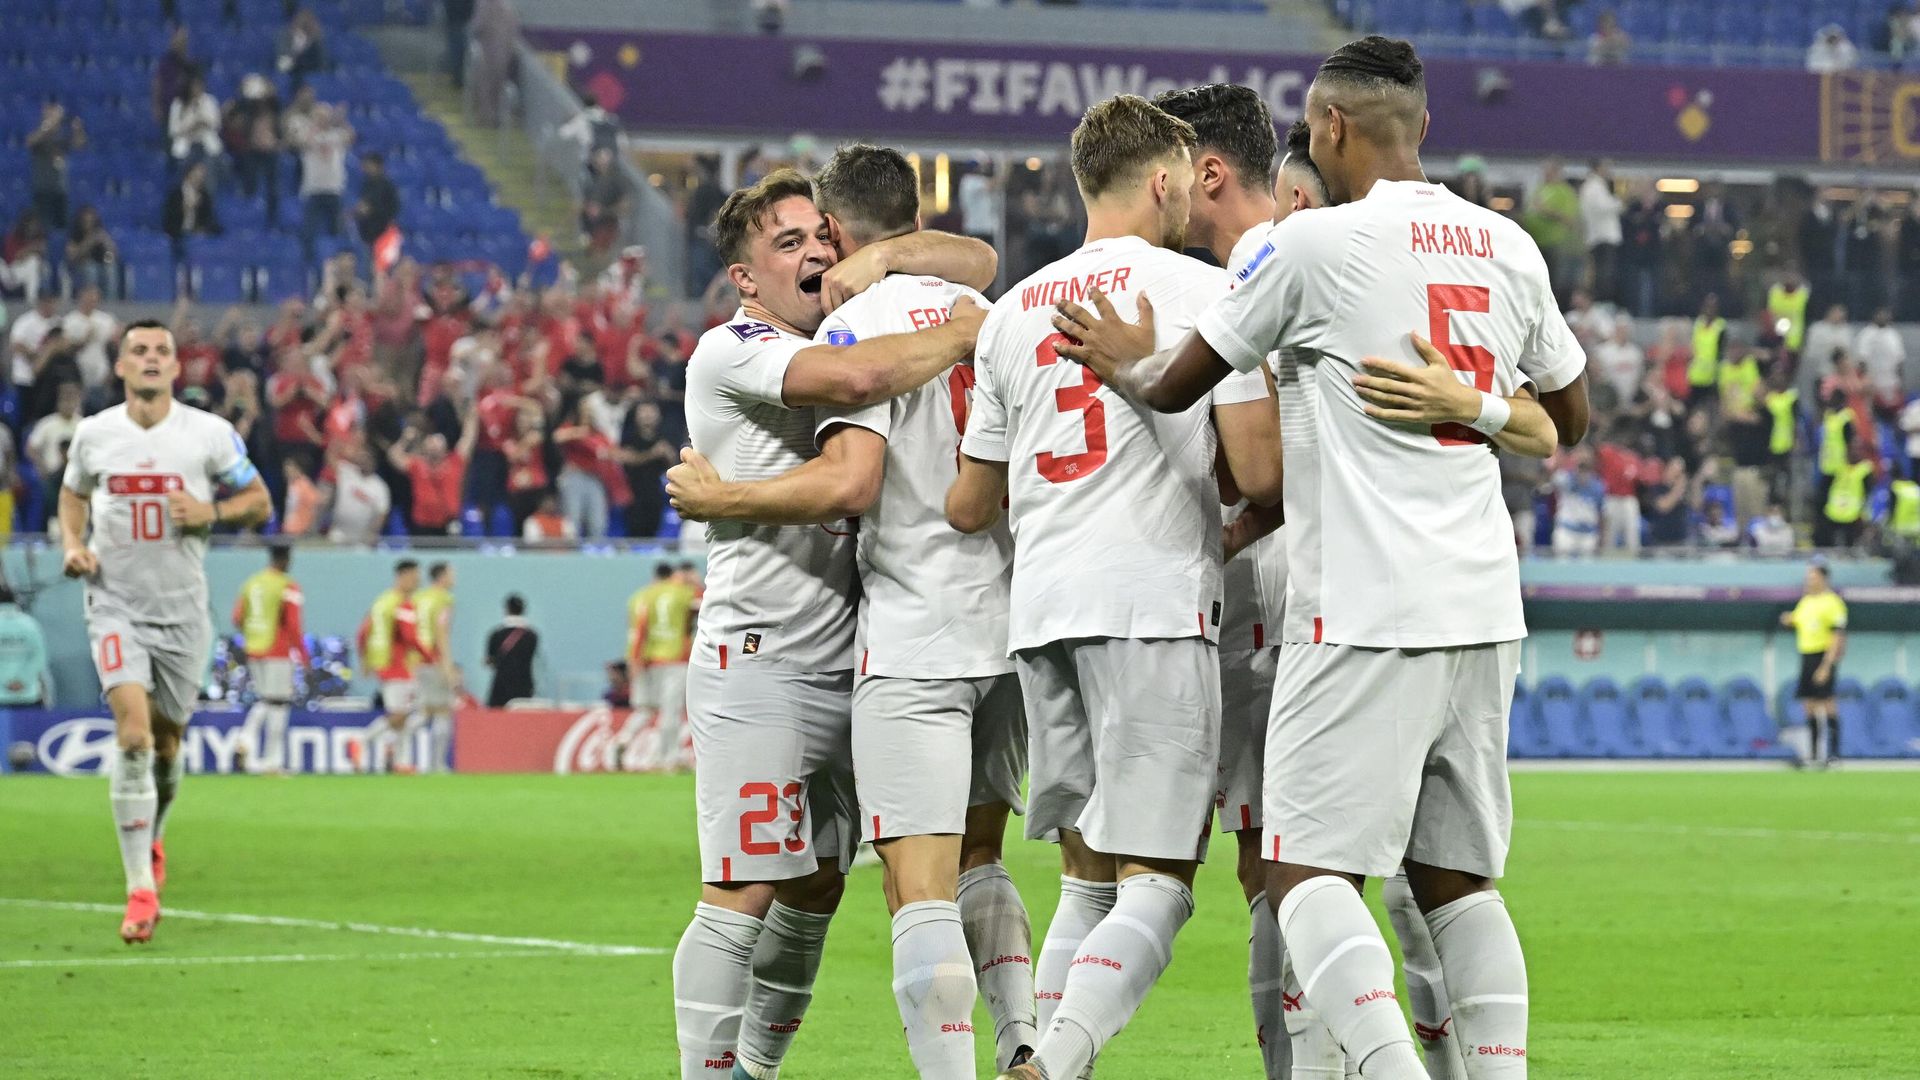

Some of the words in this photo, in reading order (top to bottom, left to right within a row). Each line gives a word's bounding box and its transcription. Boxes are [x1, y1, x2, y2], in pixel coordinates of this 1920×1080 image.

[1411, 221, 1494, 259] AKANJI
[1021, 267, 1131, 312] WIDMER
[1427, 284, 1495, 446] 5
[1035, 332, 1108, 484] 3
[130, 502, 163, 541] 10
[739, 782, 805, 855] 23
[981, 954, 1031, 972] suisse
